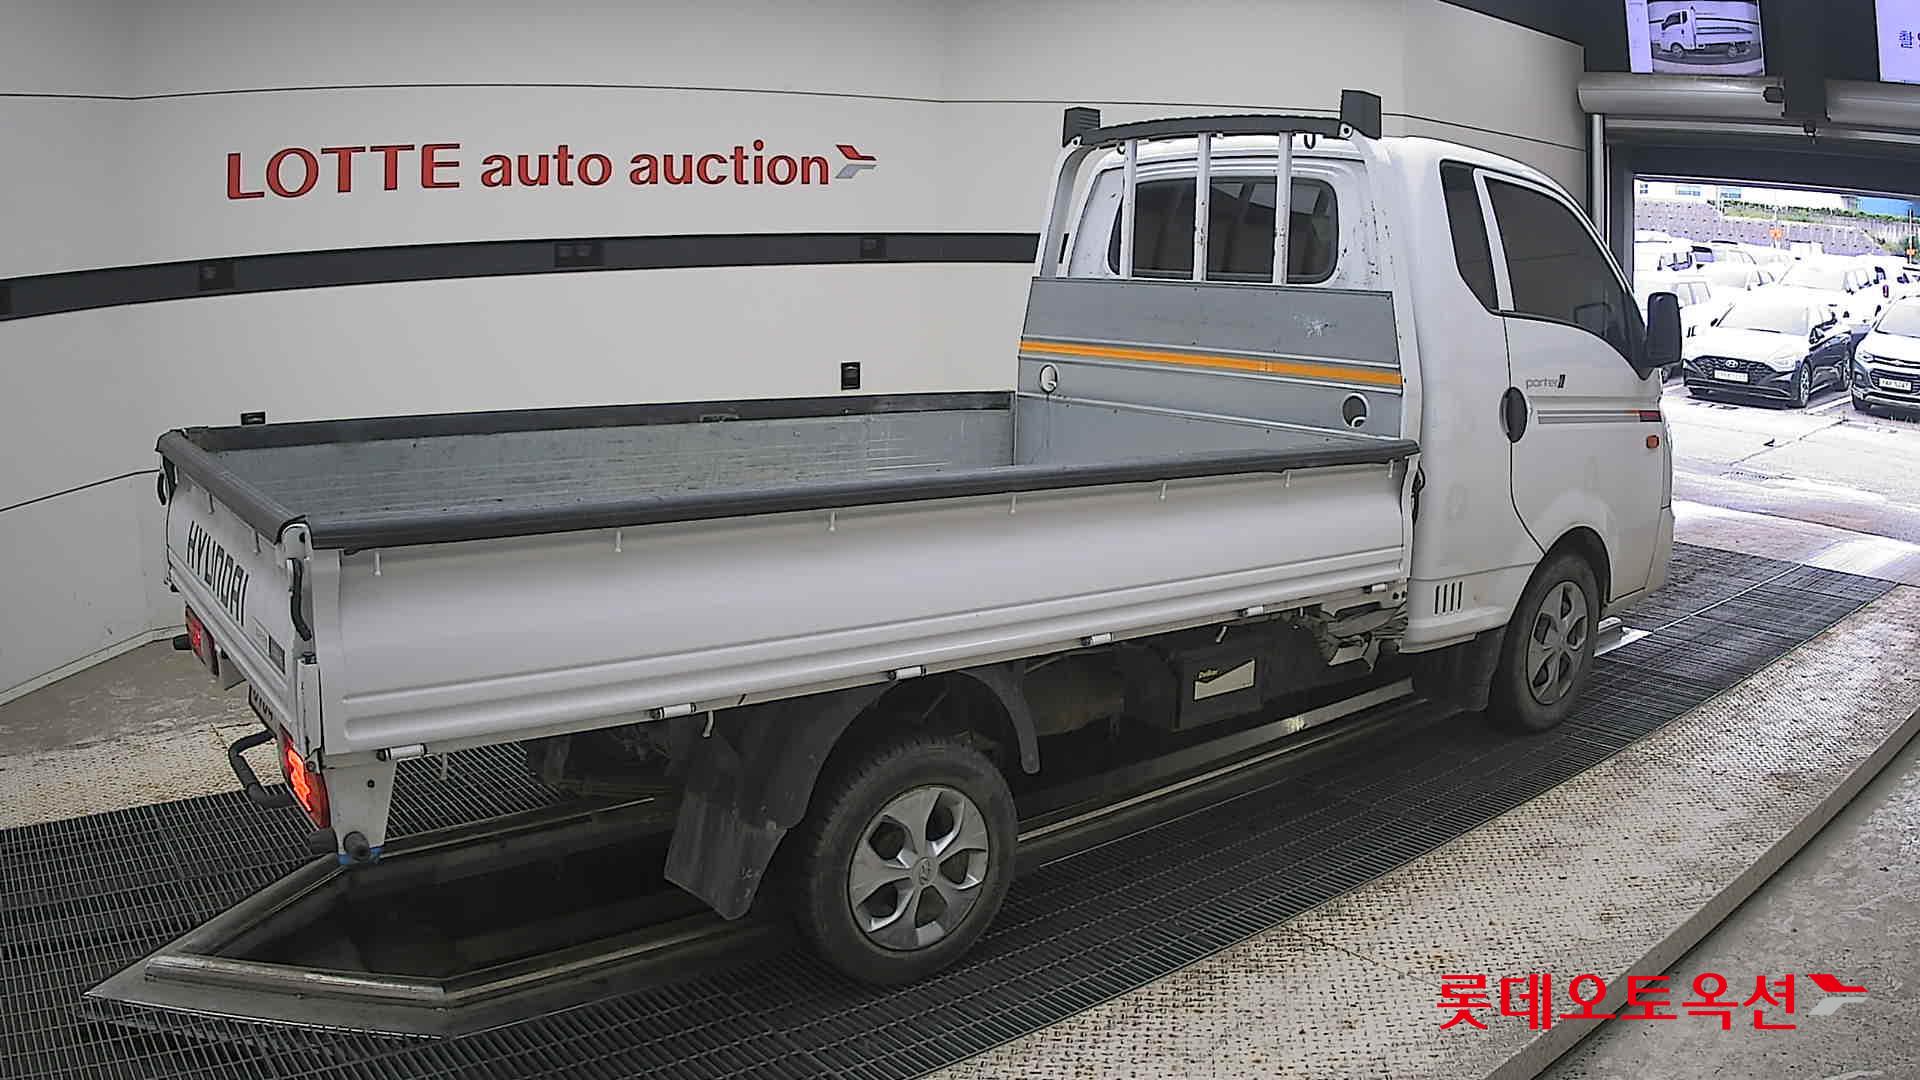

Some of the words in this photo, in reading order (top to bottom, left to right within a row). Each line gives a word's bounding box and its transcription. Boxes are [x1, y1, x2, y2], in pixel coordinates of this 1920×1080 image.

[226, 143, 461, 200] LOTTE
[480, 144, 612, 188] auto
[629, 140, 830, 186] auction
[187, 520, 249, 627] HYUNDAI
